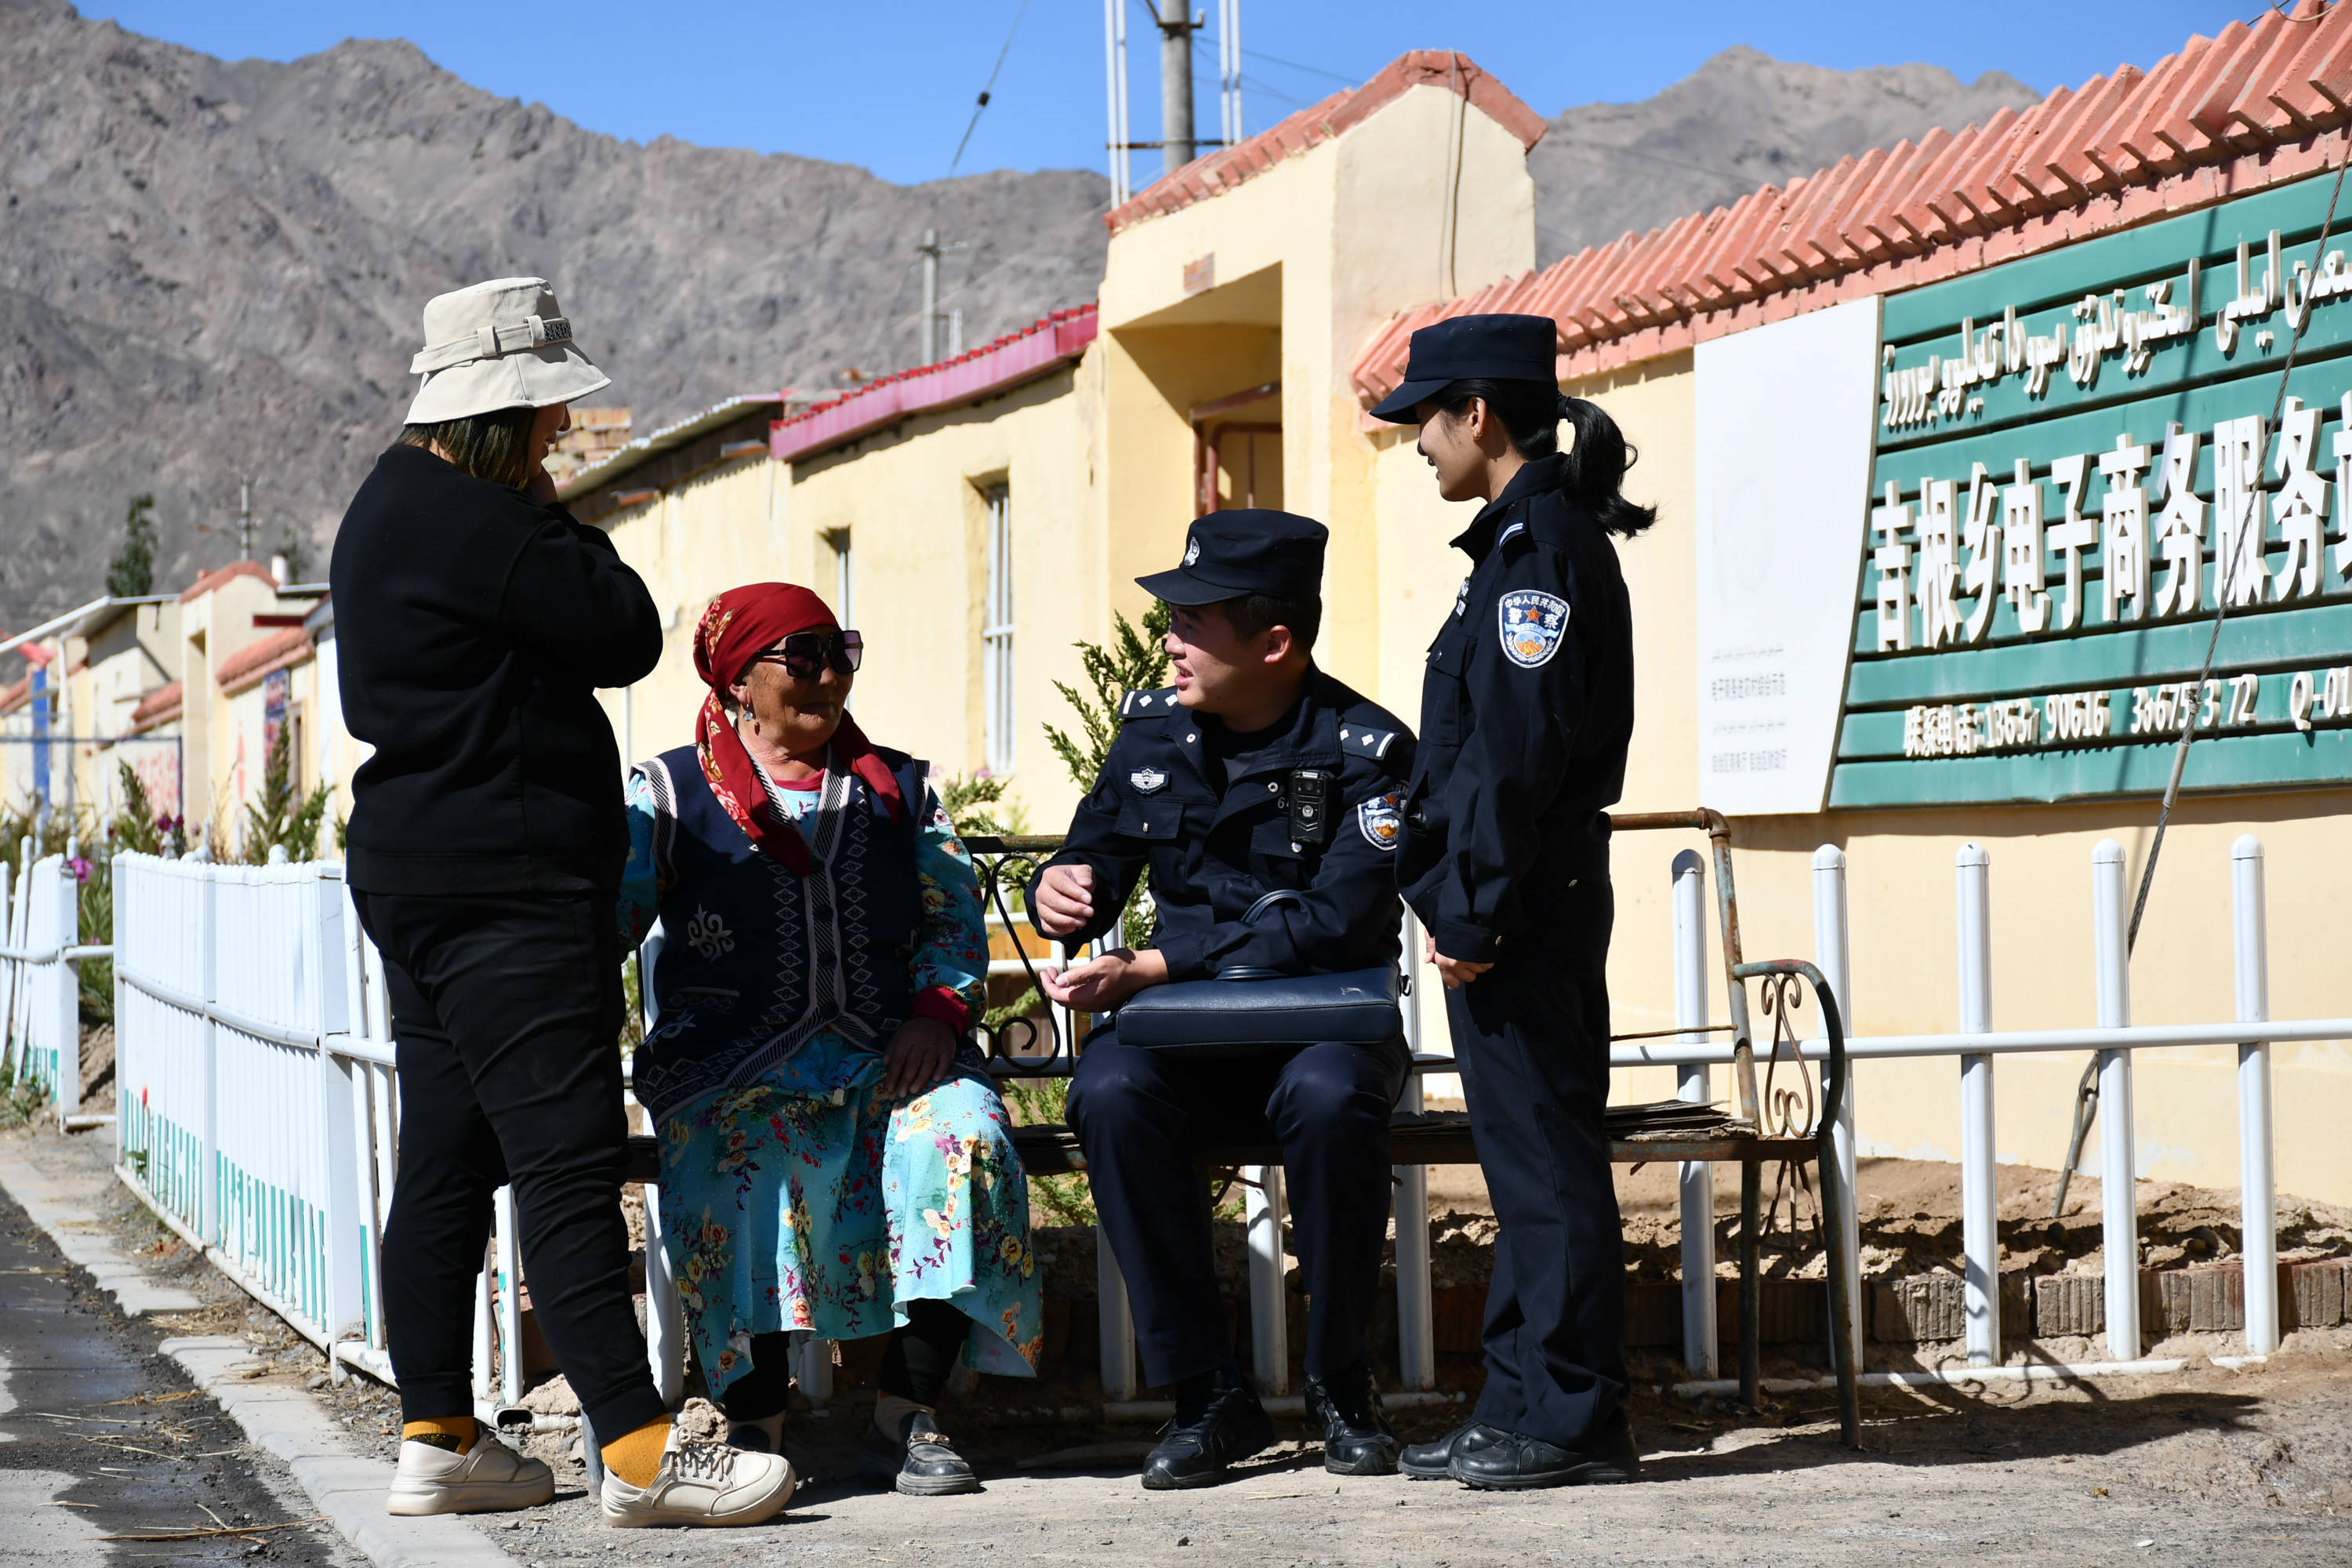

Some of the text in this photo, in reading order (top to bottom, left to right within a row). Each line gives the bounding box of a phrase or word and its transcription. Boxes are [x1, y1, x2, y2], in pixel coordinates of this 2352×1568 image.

[1504, 594, 1566, 617] 中华人民共和国
